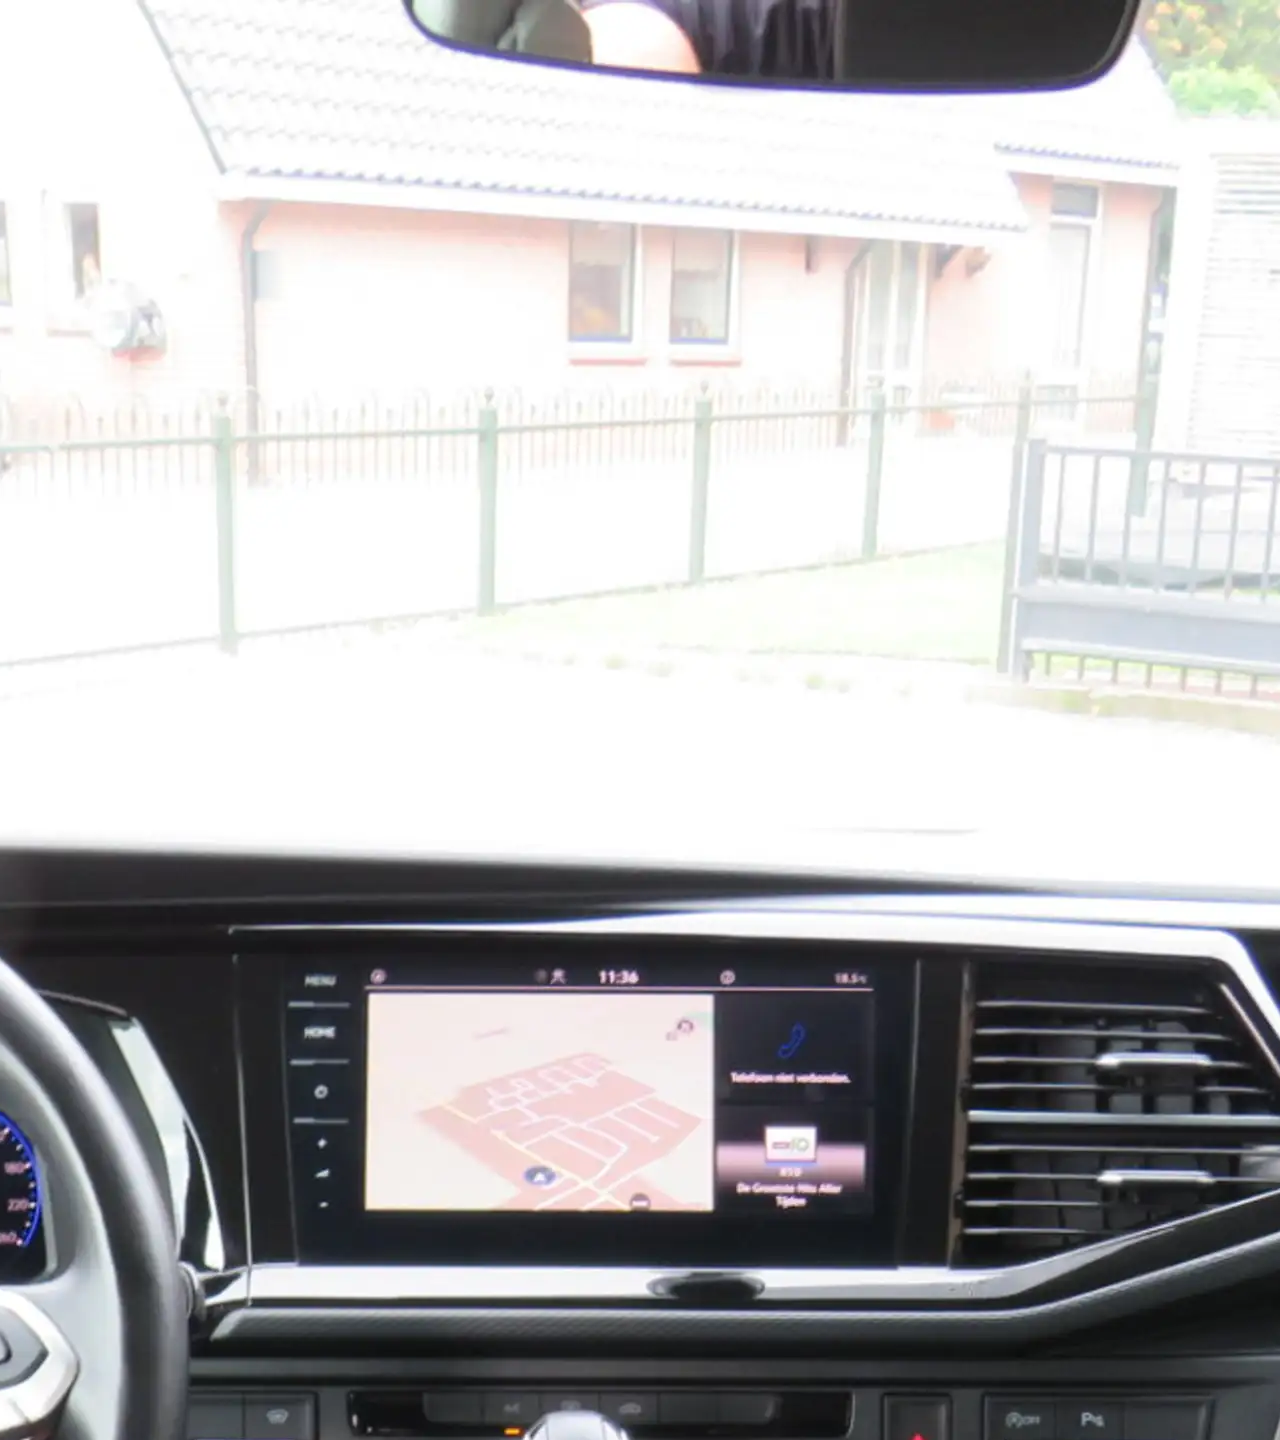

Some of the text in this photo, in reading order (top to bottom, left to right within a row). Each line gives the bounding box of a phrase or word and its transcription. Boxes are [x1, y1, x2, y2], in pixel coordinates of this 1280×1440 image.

[304, 975, 336, 987] MENU
[599, 970, 639, 985] 11:36
[304, 1026, 336, 1039] HOME
